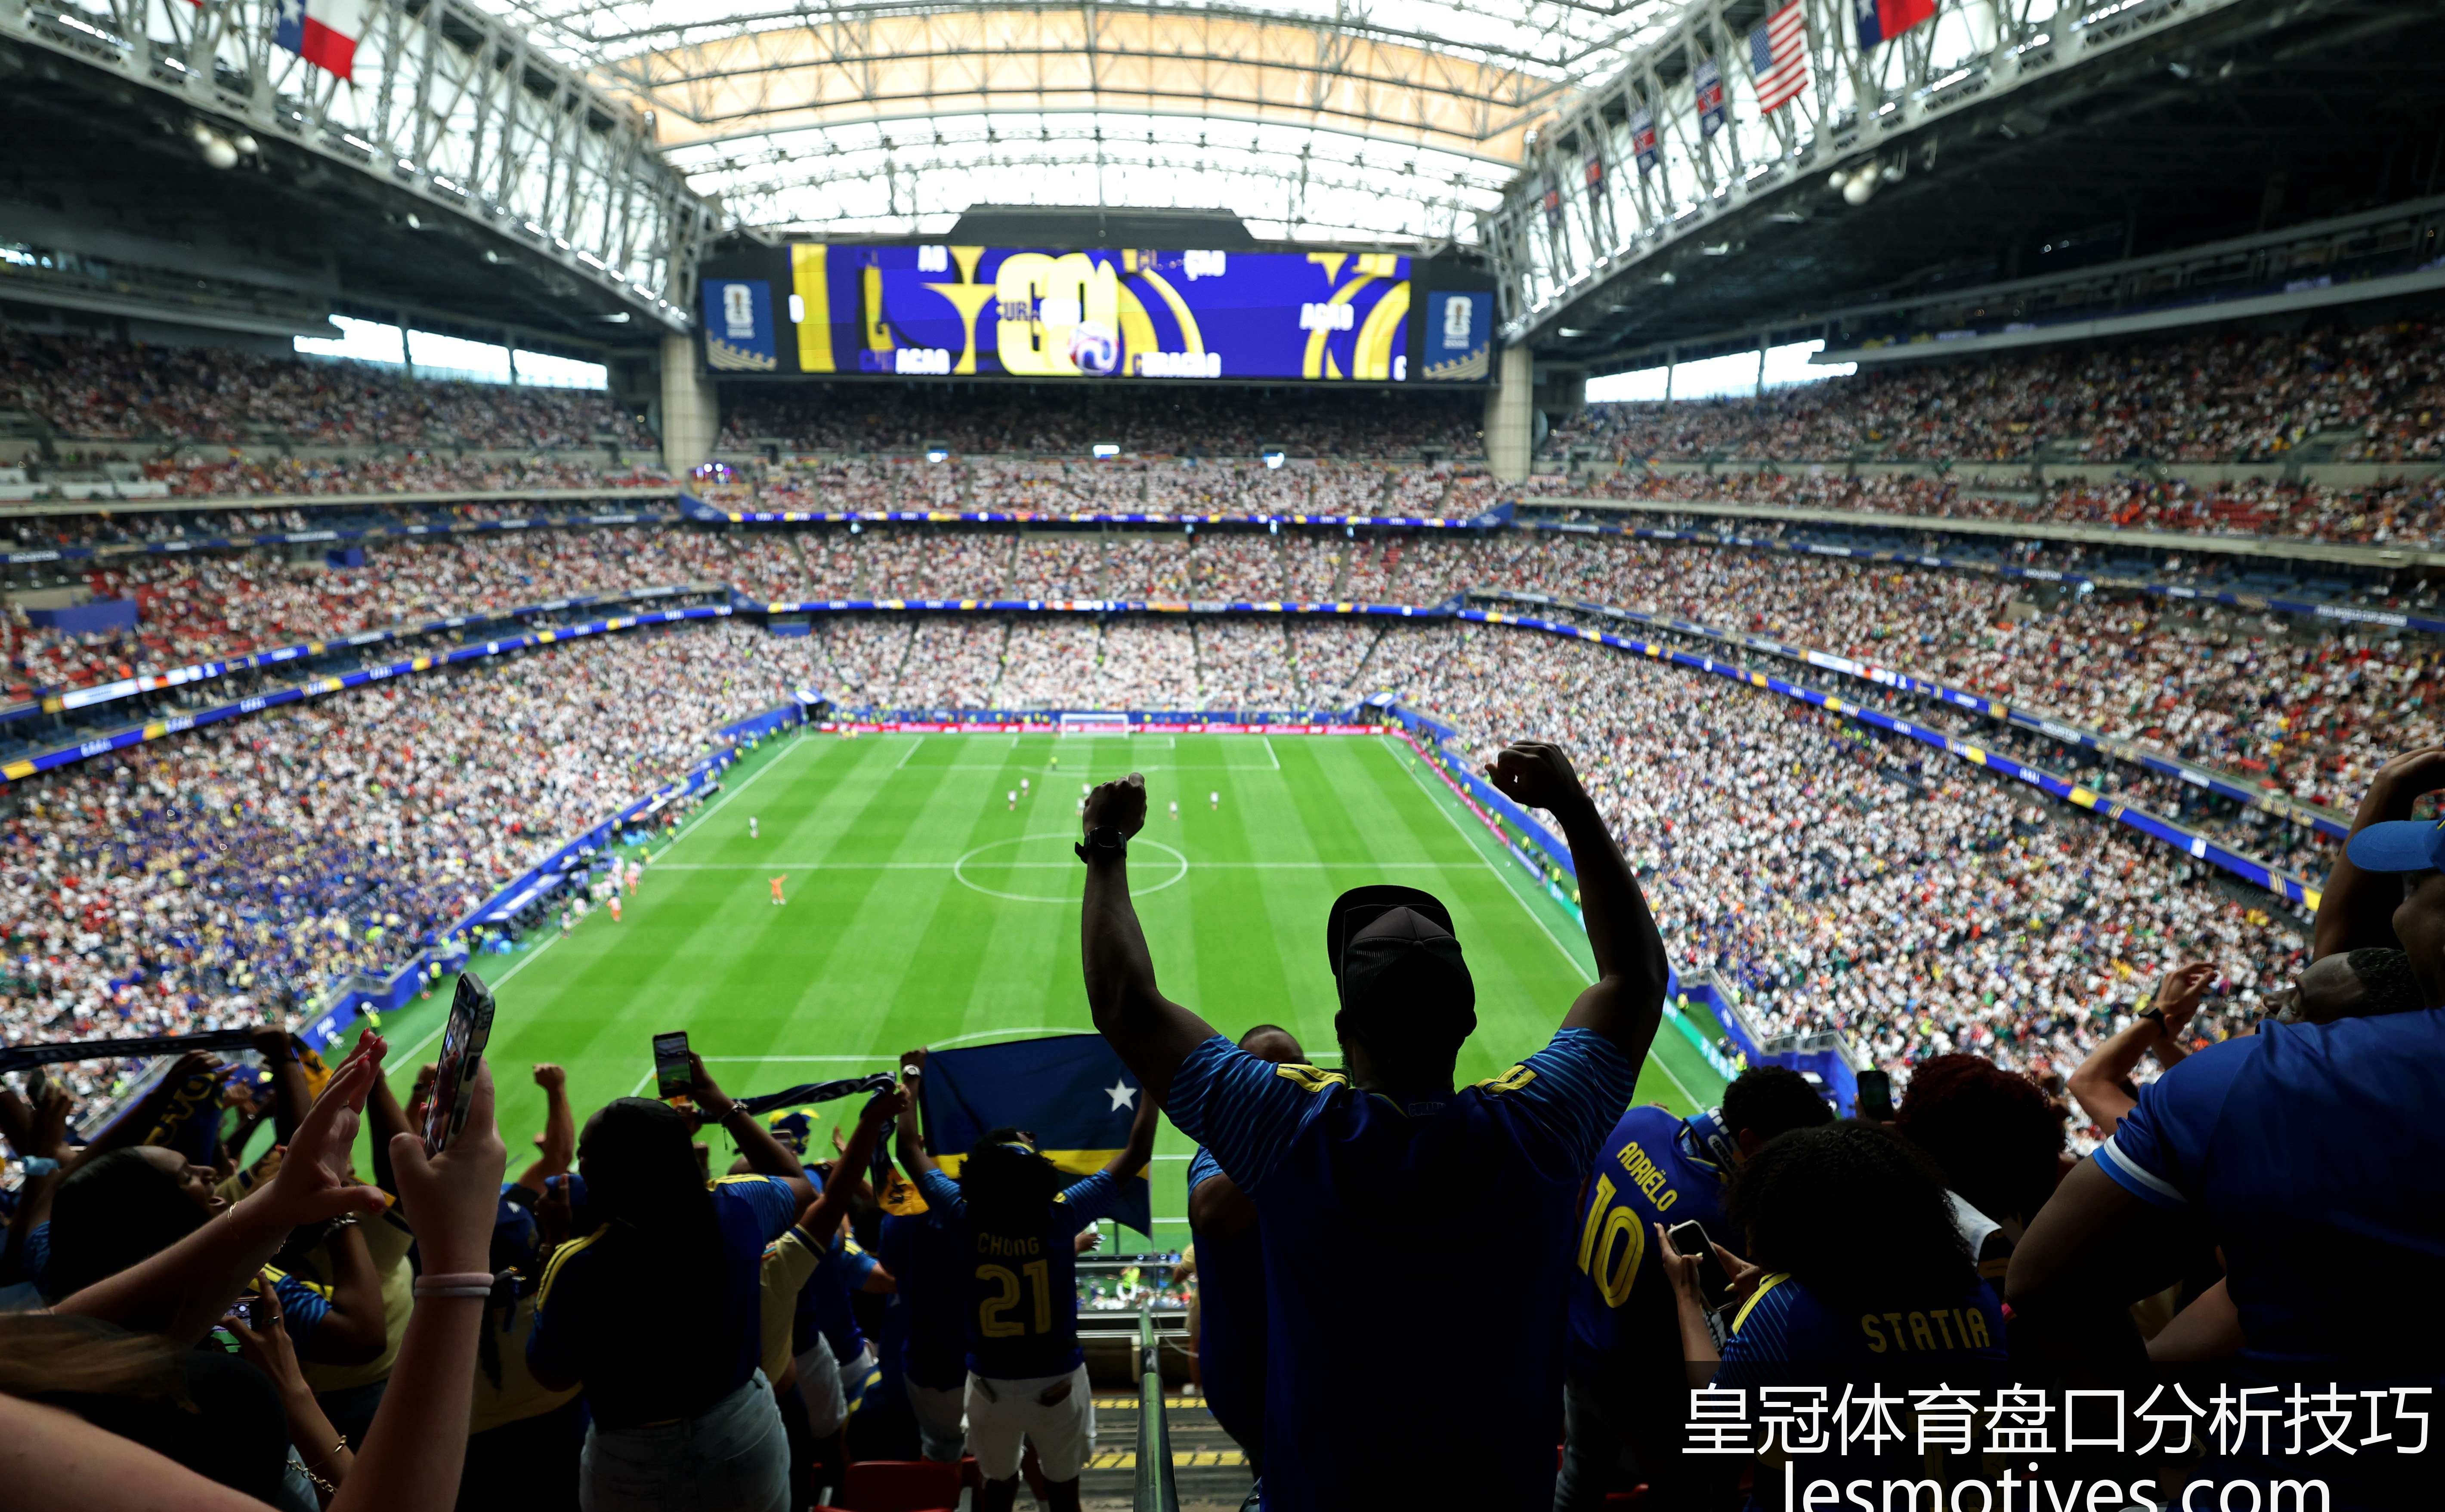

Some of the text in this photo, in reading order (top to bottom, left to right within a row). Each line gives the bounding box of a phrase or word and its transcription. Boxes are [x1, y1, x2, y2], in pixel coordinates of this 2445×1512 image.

[1616, 1141, 1678, 1212] ADRIËLO
[1577, 1173, 1644, 1308] 10
[975, 1259, 1051, 1337] 21
[1861, 1308, 1991, 1353] STATIA
